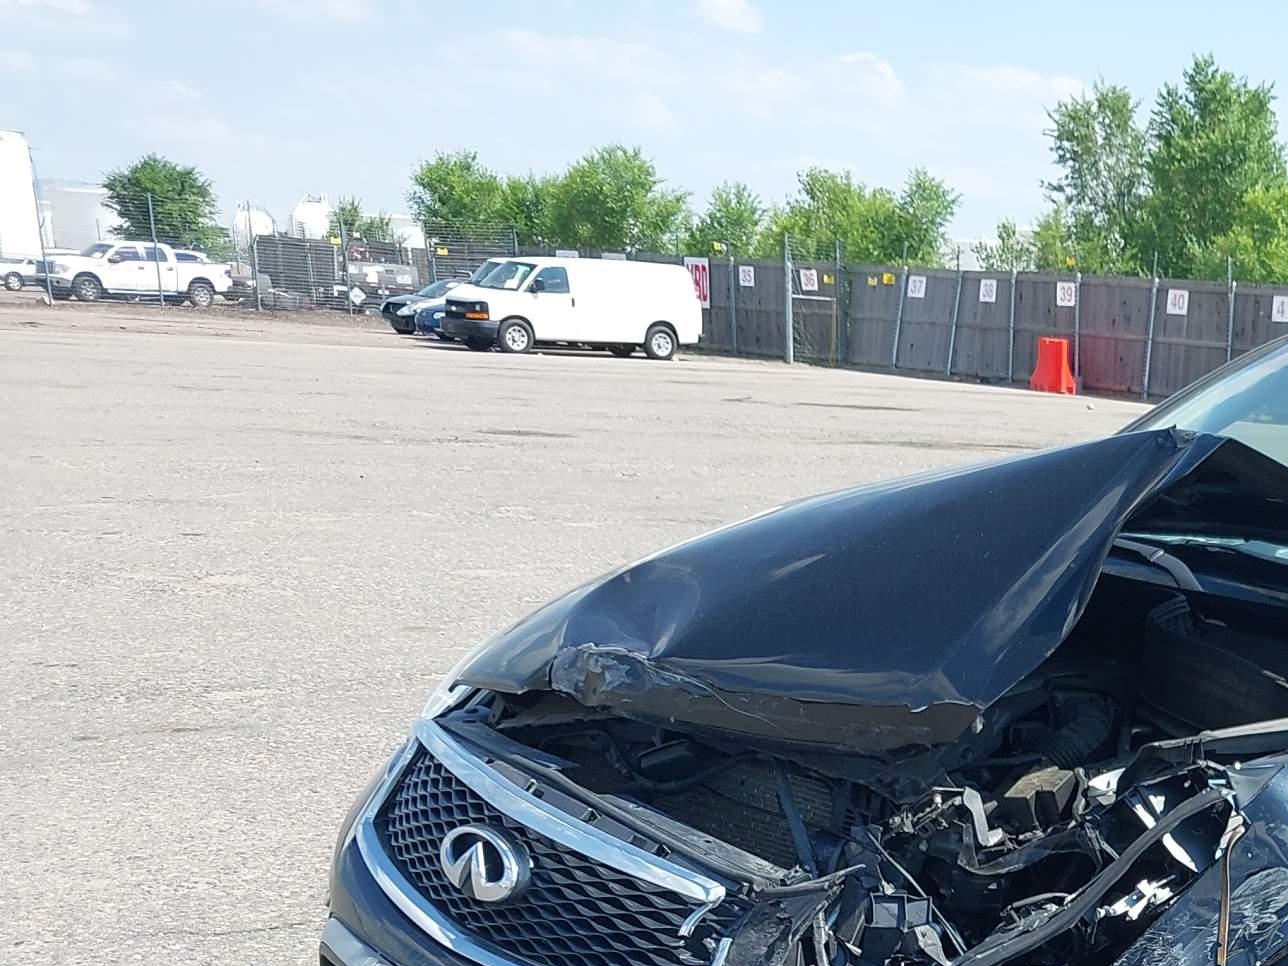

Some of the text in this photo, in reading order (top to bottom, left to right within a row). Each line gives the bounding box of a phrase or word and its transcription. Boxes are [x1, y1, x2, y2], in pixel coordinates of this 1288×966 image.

[740, 269, 752, 283] 35
[802, 272, 816, 287] 36
[910, 279, 924, 294] 37
[1059, 286, 1073, 302] 39
[1170, 293, 1185, 310] 40
